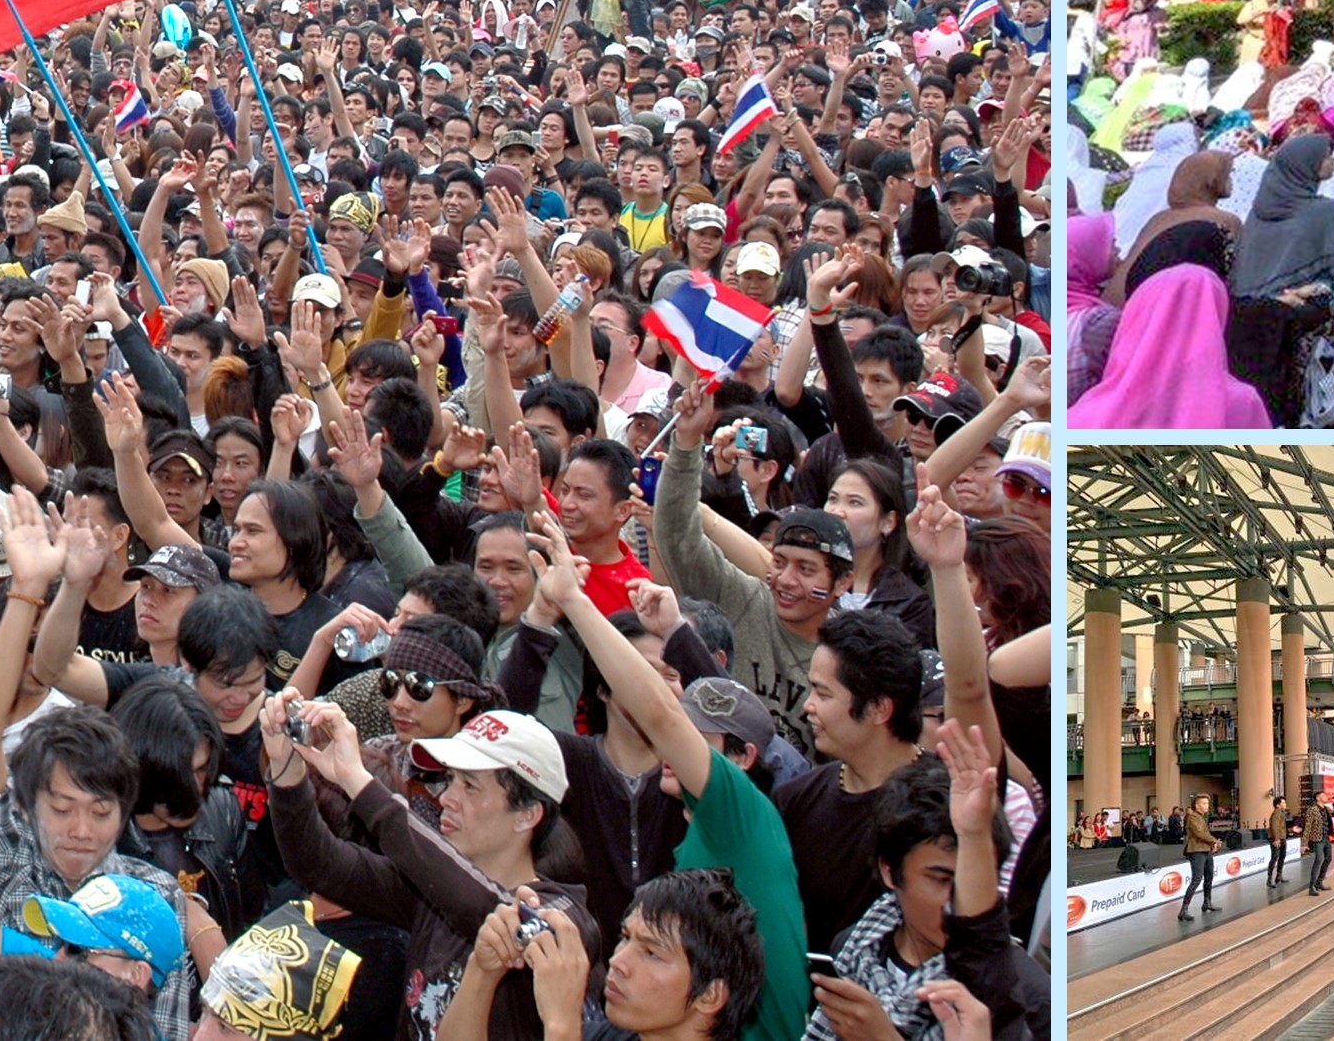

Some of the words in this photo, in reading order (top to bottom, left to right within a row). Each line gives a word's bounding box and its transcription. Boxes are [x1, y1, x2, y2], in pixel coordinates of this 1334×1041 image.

[91, 648, 139, 664] STYL
[751, 662, 809, 724] LIV
[1091, 892, 1126, 912] Prepaid
[1127, 886, 1146, 902] Card
